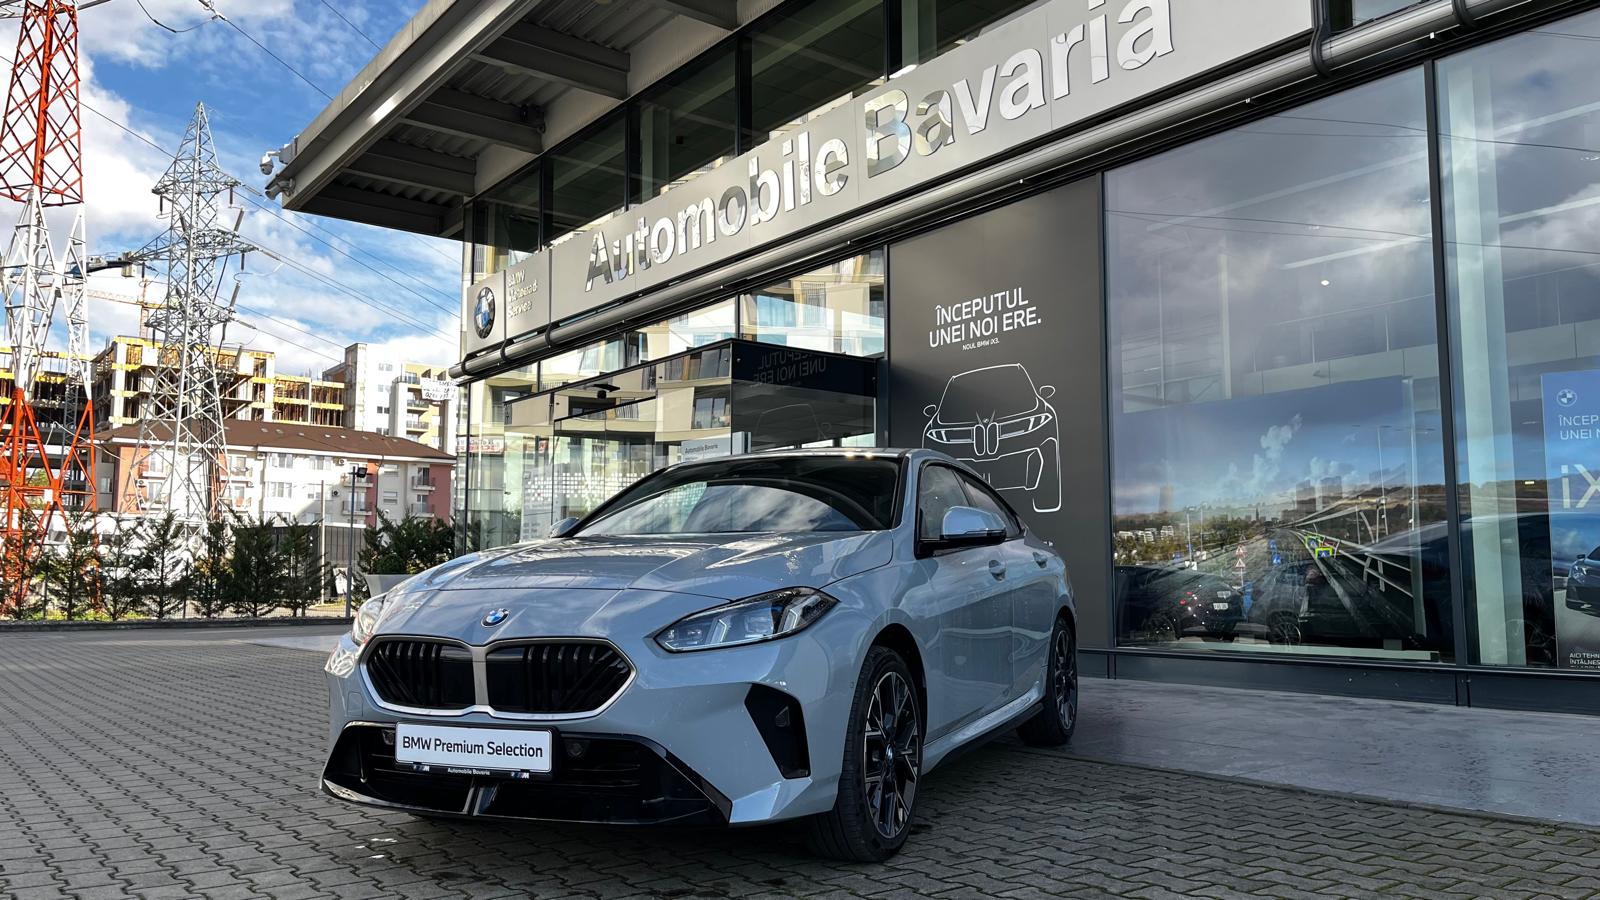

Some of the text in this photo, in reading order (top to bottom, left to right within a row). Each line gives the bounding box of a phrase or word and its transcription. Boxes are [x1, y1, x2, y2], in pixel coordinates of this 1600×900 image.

[584, 0, 1176, 292] Automobile Bavaria
[935, 287, 1029, 326] ÎNCEPUTUL
[929, 306, 1042, 348] UNEI NOI ERE.
[962, 342, 977, 351] NOUL
[977, 339, 990, 348] BMW
[1560, 428, 1592, 440] UNEI
[402, 736, 543, 758] BMW Premium Selection
[447, 767, 472, 775] Automobile
